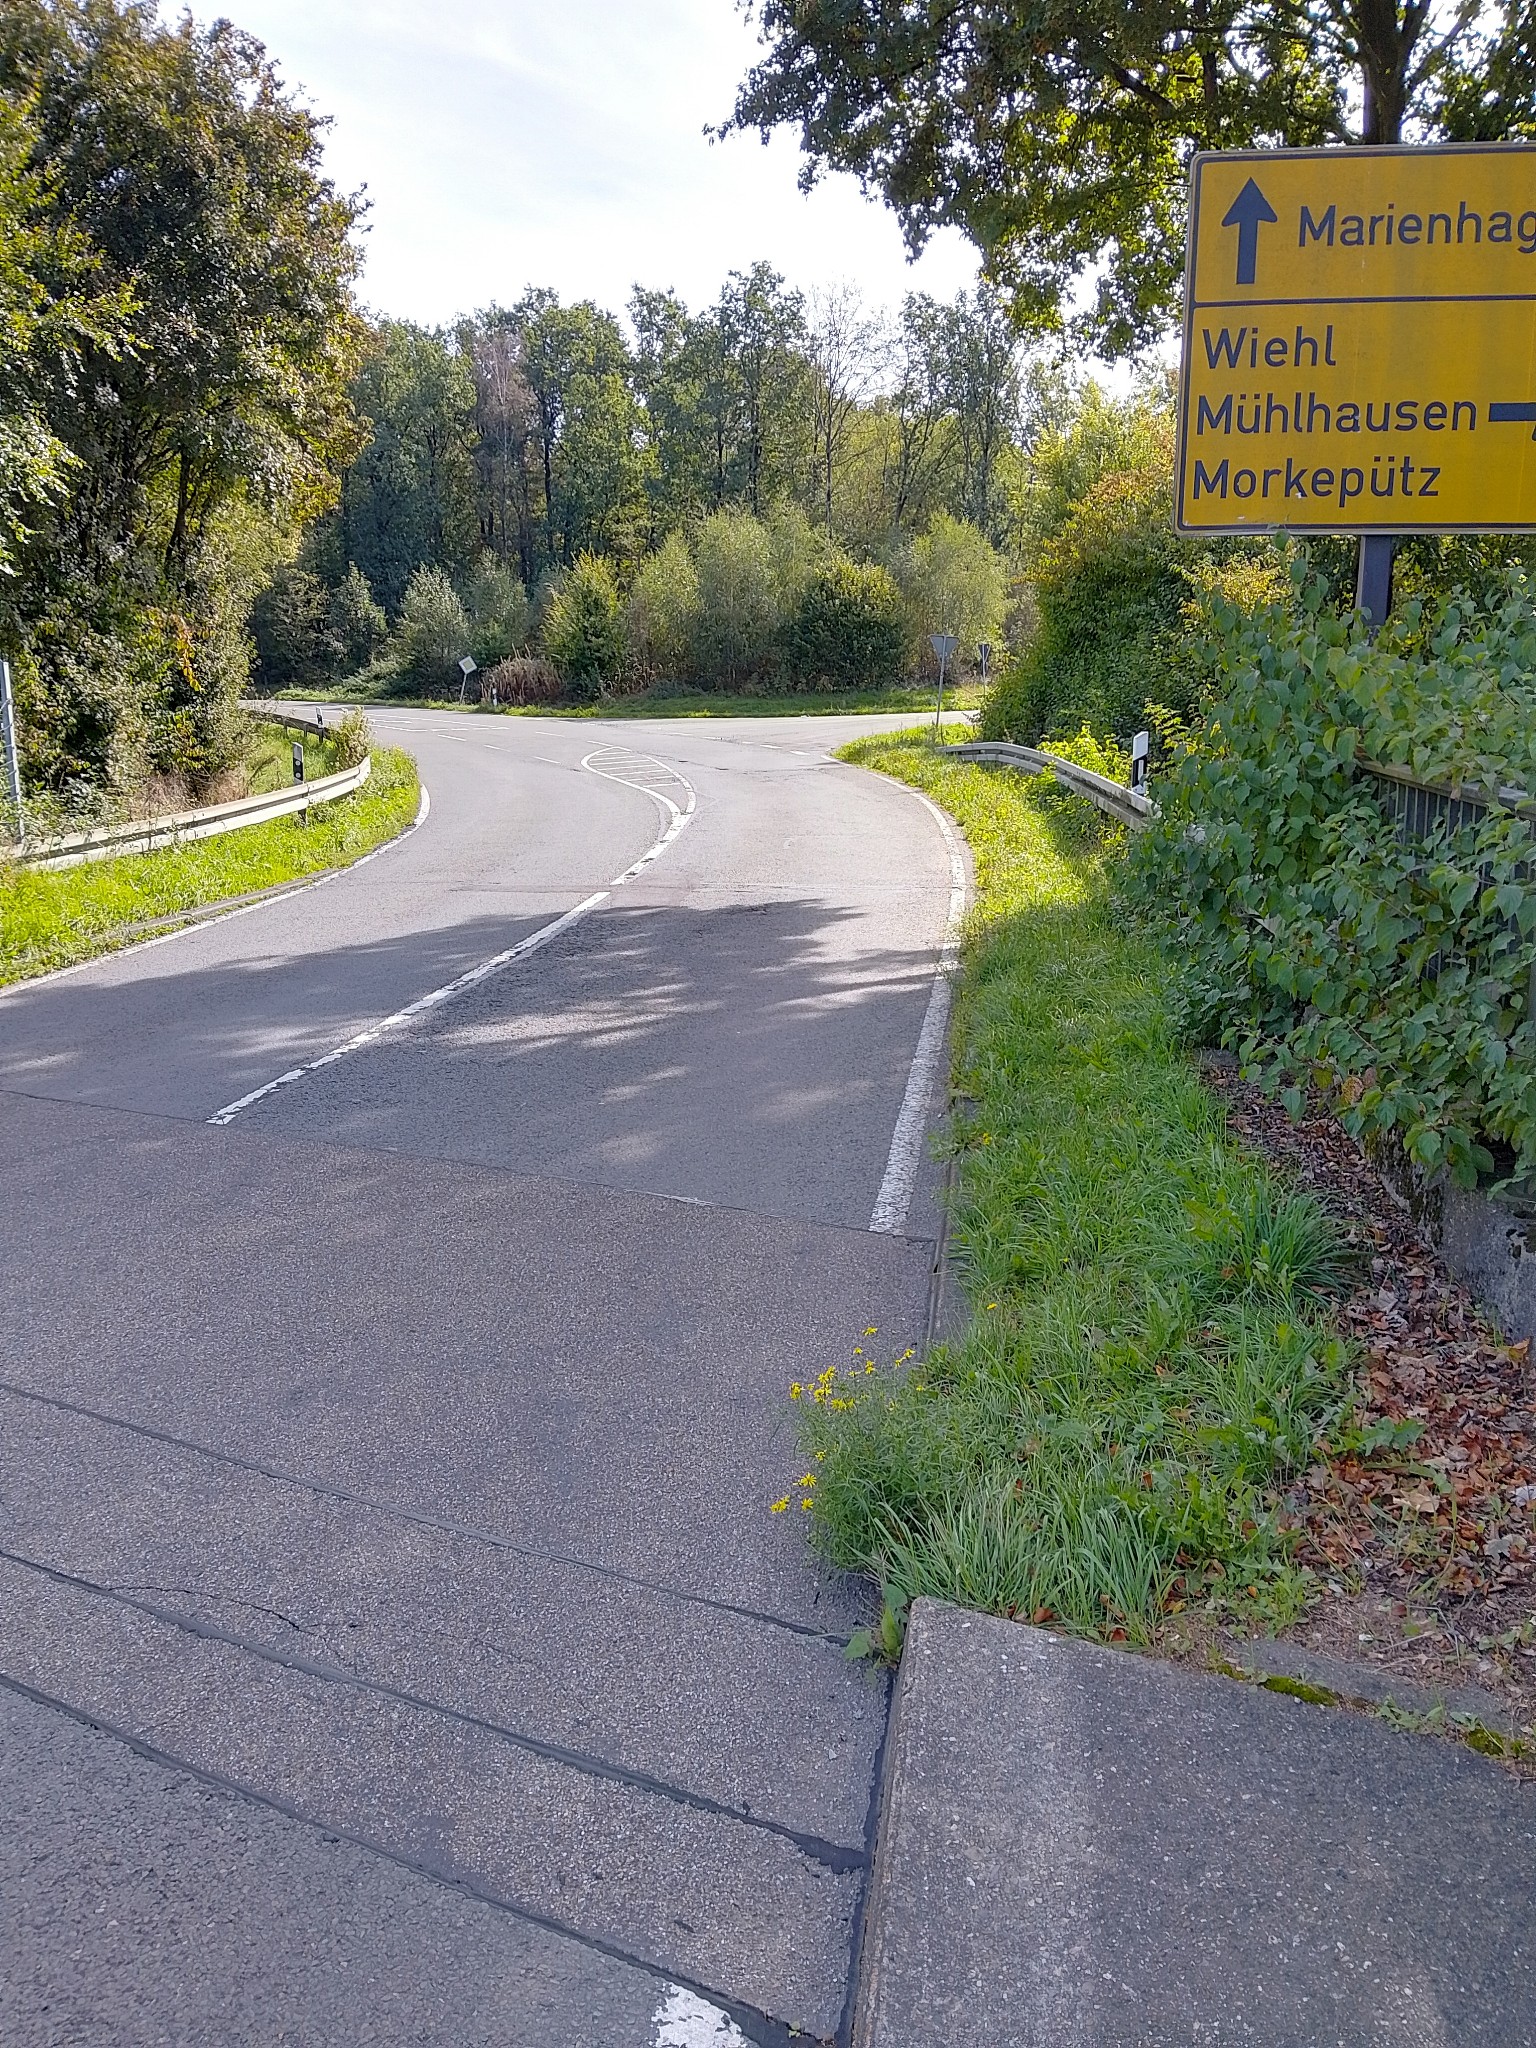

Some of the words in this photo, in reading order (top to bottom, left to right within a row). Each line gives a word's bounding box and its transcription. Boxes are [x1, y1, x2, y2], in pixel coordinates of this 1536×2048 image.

[1202, 324, 1337, 369] Wiehl
[1196, 392, 1477, 436] Mühlhausen
[1193, 456, 1441, 508] Morkepütz
